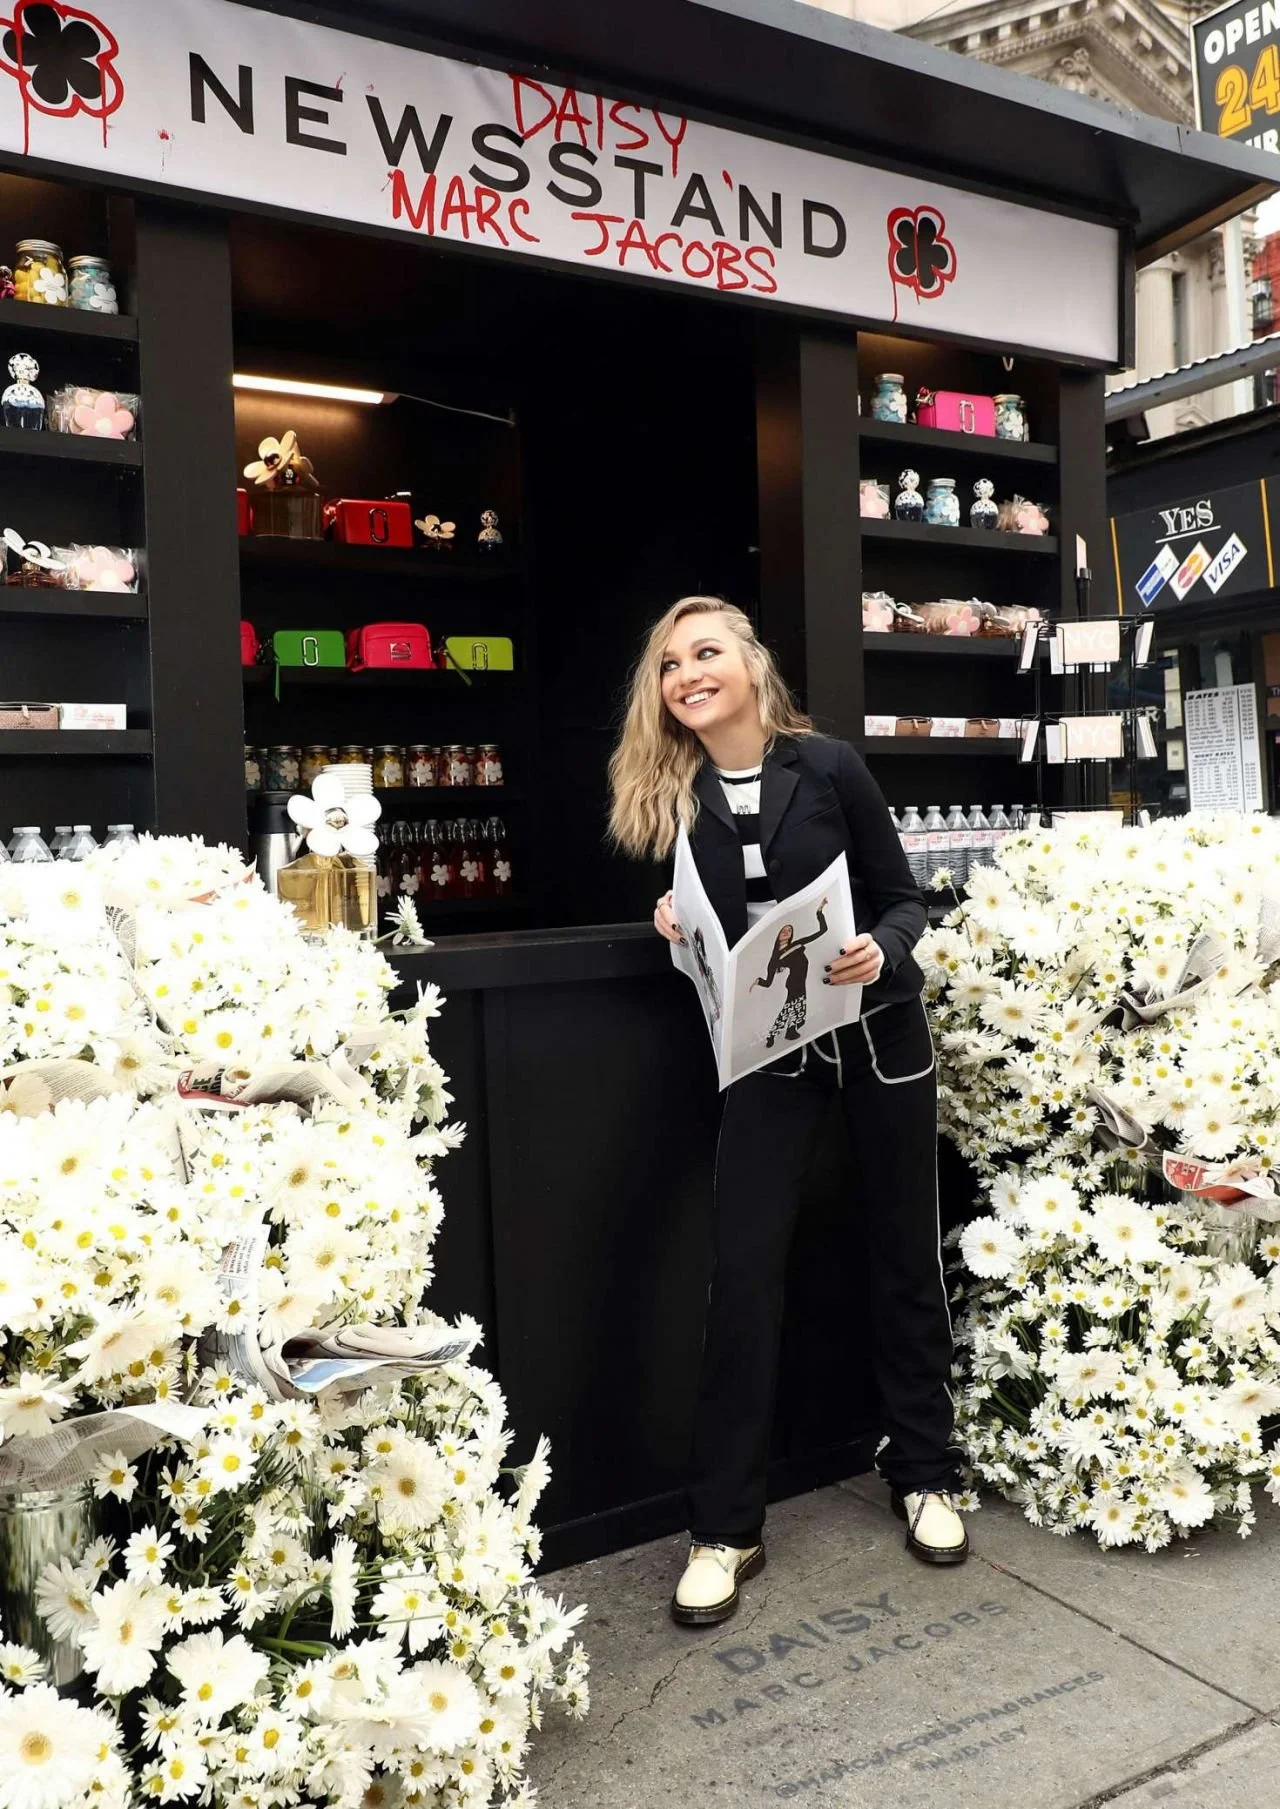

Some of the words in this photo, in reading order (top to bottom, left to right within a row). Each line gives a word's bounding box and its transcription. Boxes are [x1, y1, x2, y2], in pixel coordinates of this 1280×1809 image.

[1203, 0, 1280, 65] OPEN
[508, 73, 688, 177] DAISY
[1215, 44, 1280, 138] 24
[188, 51, 848, 259] NEWSSTAND
[391, 169, 541, 247] MARC
[570, 211, 778, 293] JACOBS
[1159, 500, 1214, 536] YES
[1208, 543, 1241, 584] VISA
[1067, 631, 1114, 652] NYC
[1188, 691, 1219, 700] RATES
[1069, 724, 1118, 746] NYC
[690, 1671, 824, 1730] MARC
[842, 1600, 1010, 1674] JACOBS
[714, 1592, 902, 1677] DAISY
